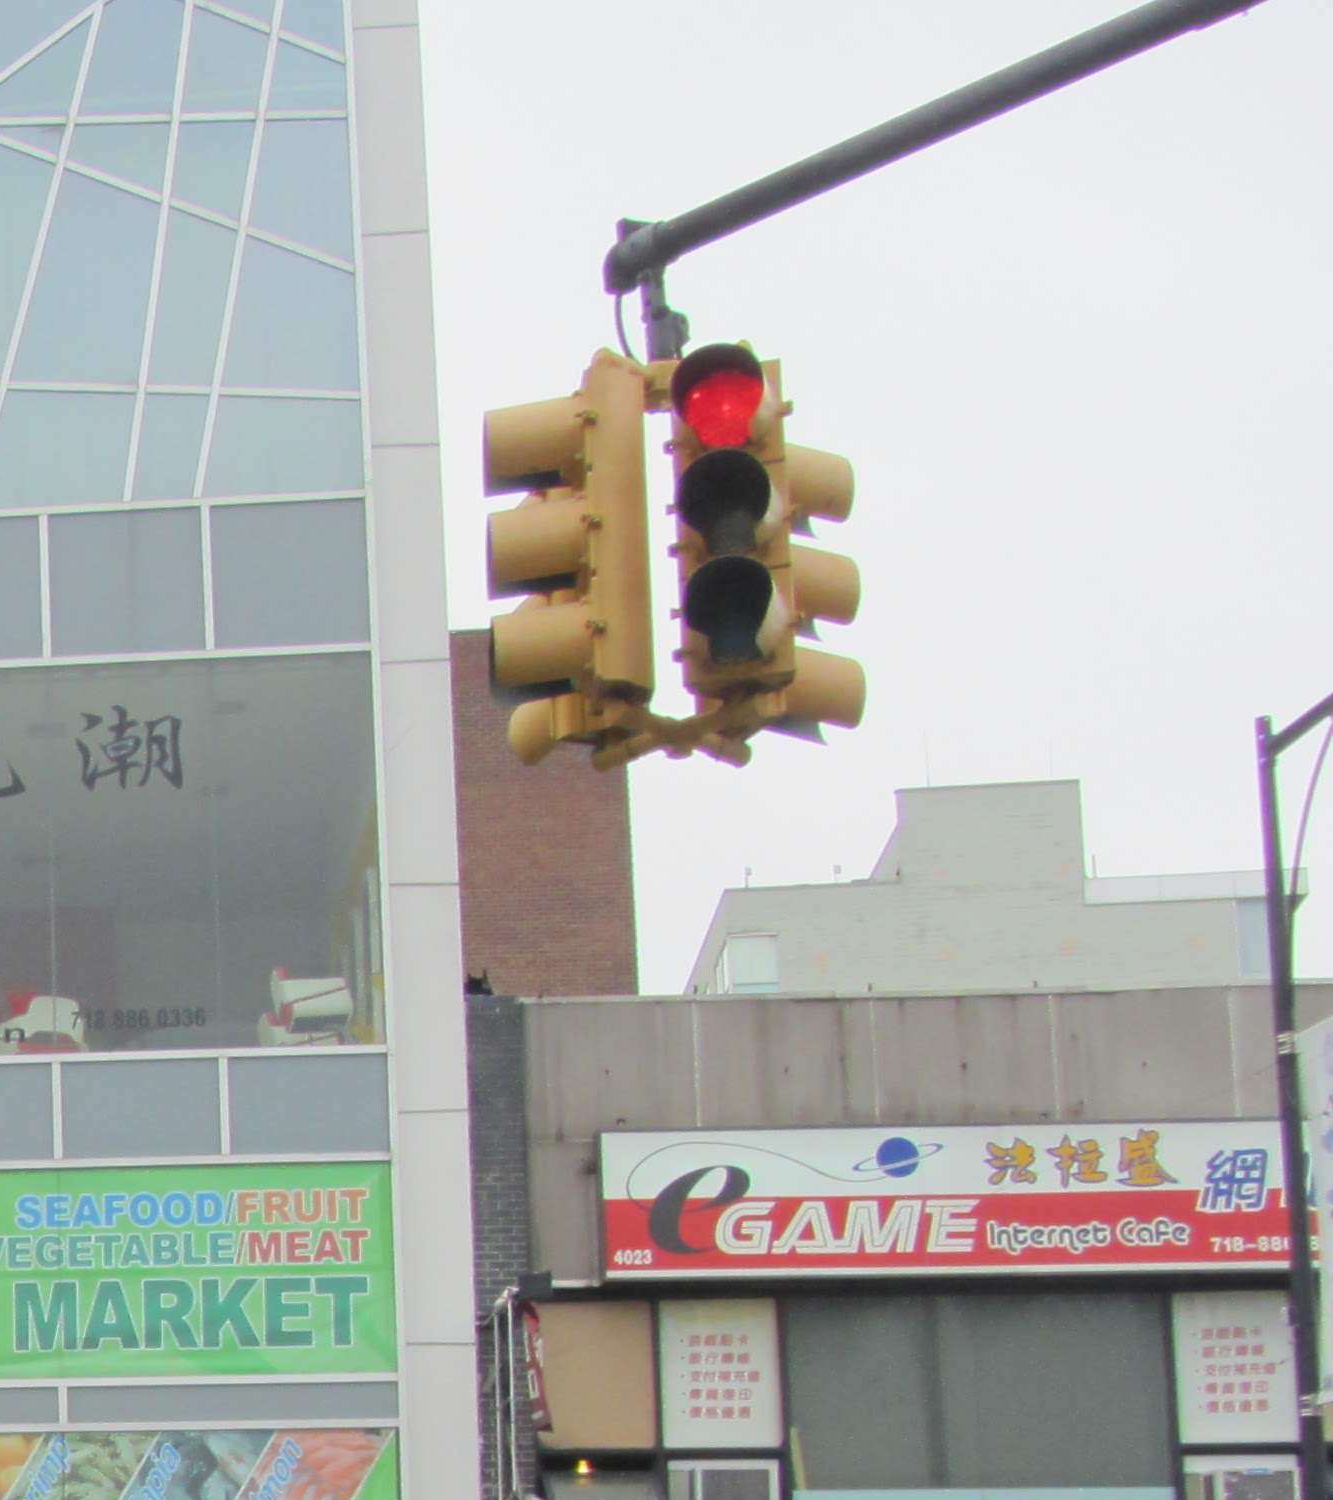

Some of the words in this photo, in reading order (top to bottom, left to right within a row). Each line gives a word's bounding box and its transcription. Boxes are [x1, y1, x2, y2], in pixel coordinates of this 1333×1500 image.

[985, 1128, 1180, 1189] 法拉盛
[15, 1187, 369, 1231] SEAFOOD/FRUIT
[987, 1218, 1109, 1252] Internet
[1116, 1217, 1191, 1248] Cafe
[613, 1249, 653, 1267] 4023
[12, 1275, 370, 1353] MARKET
